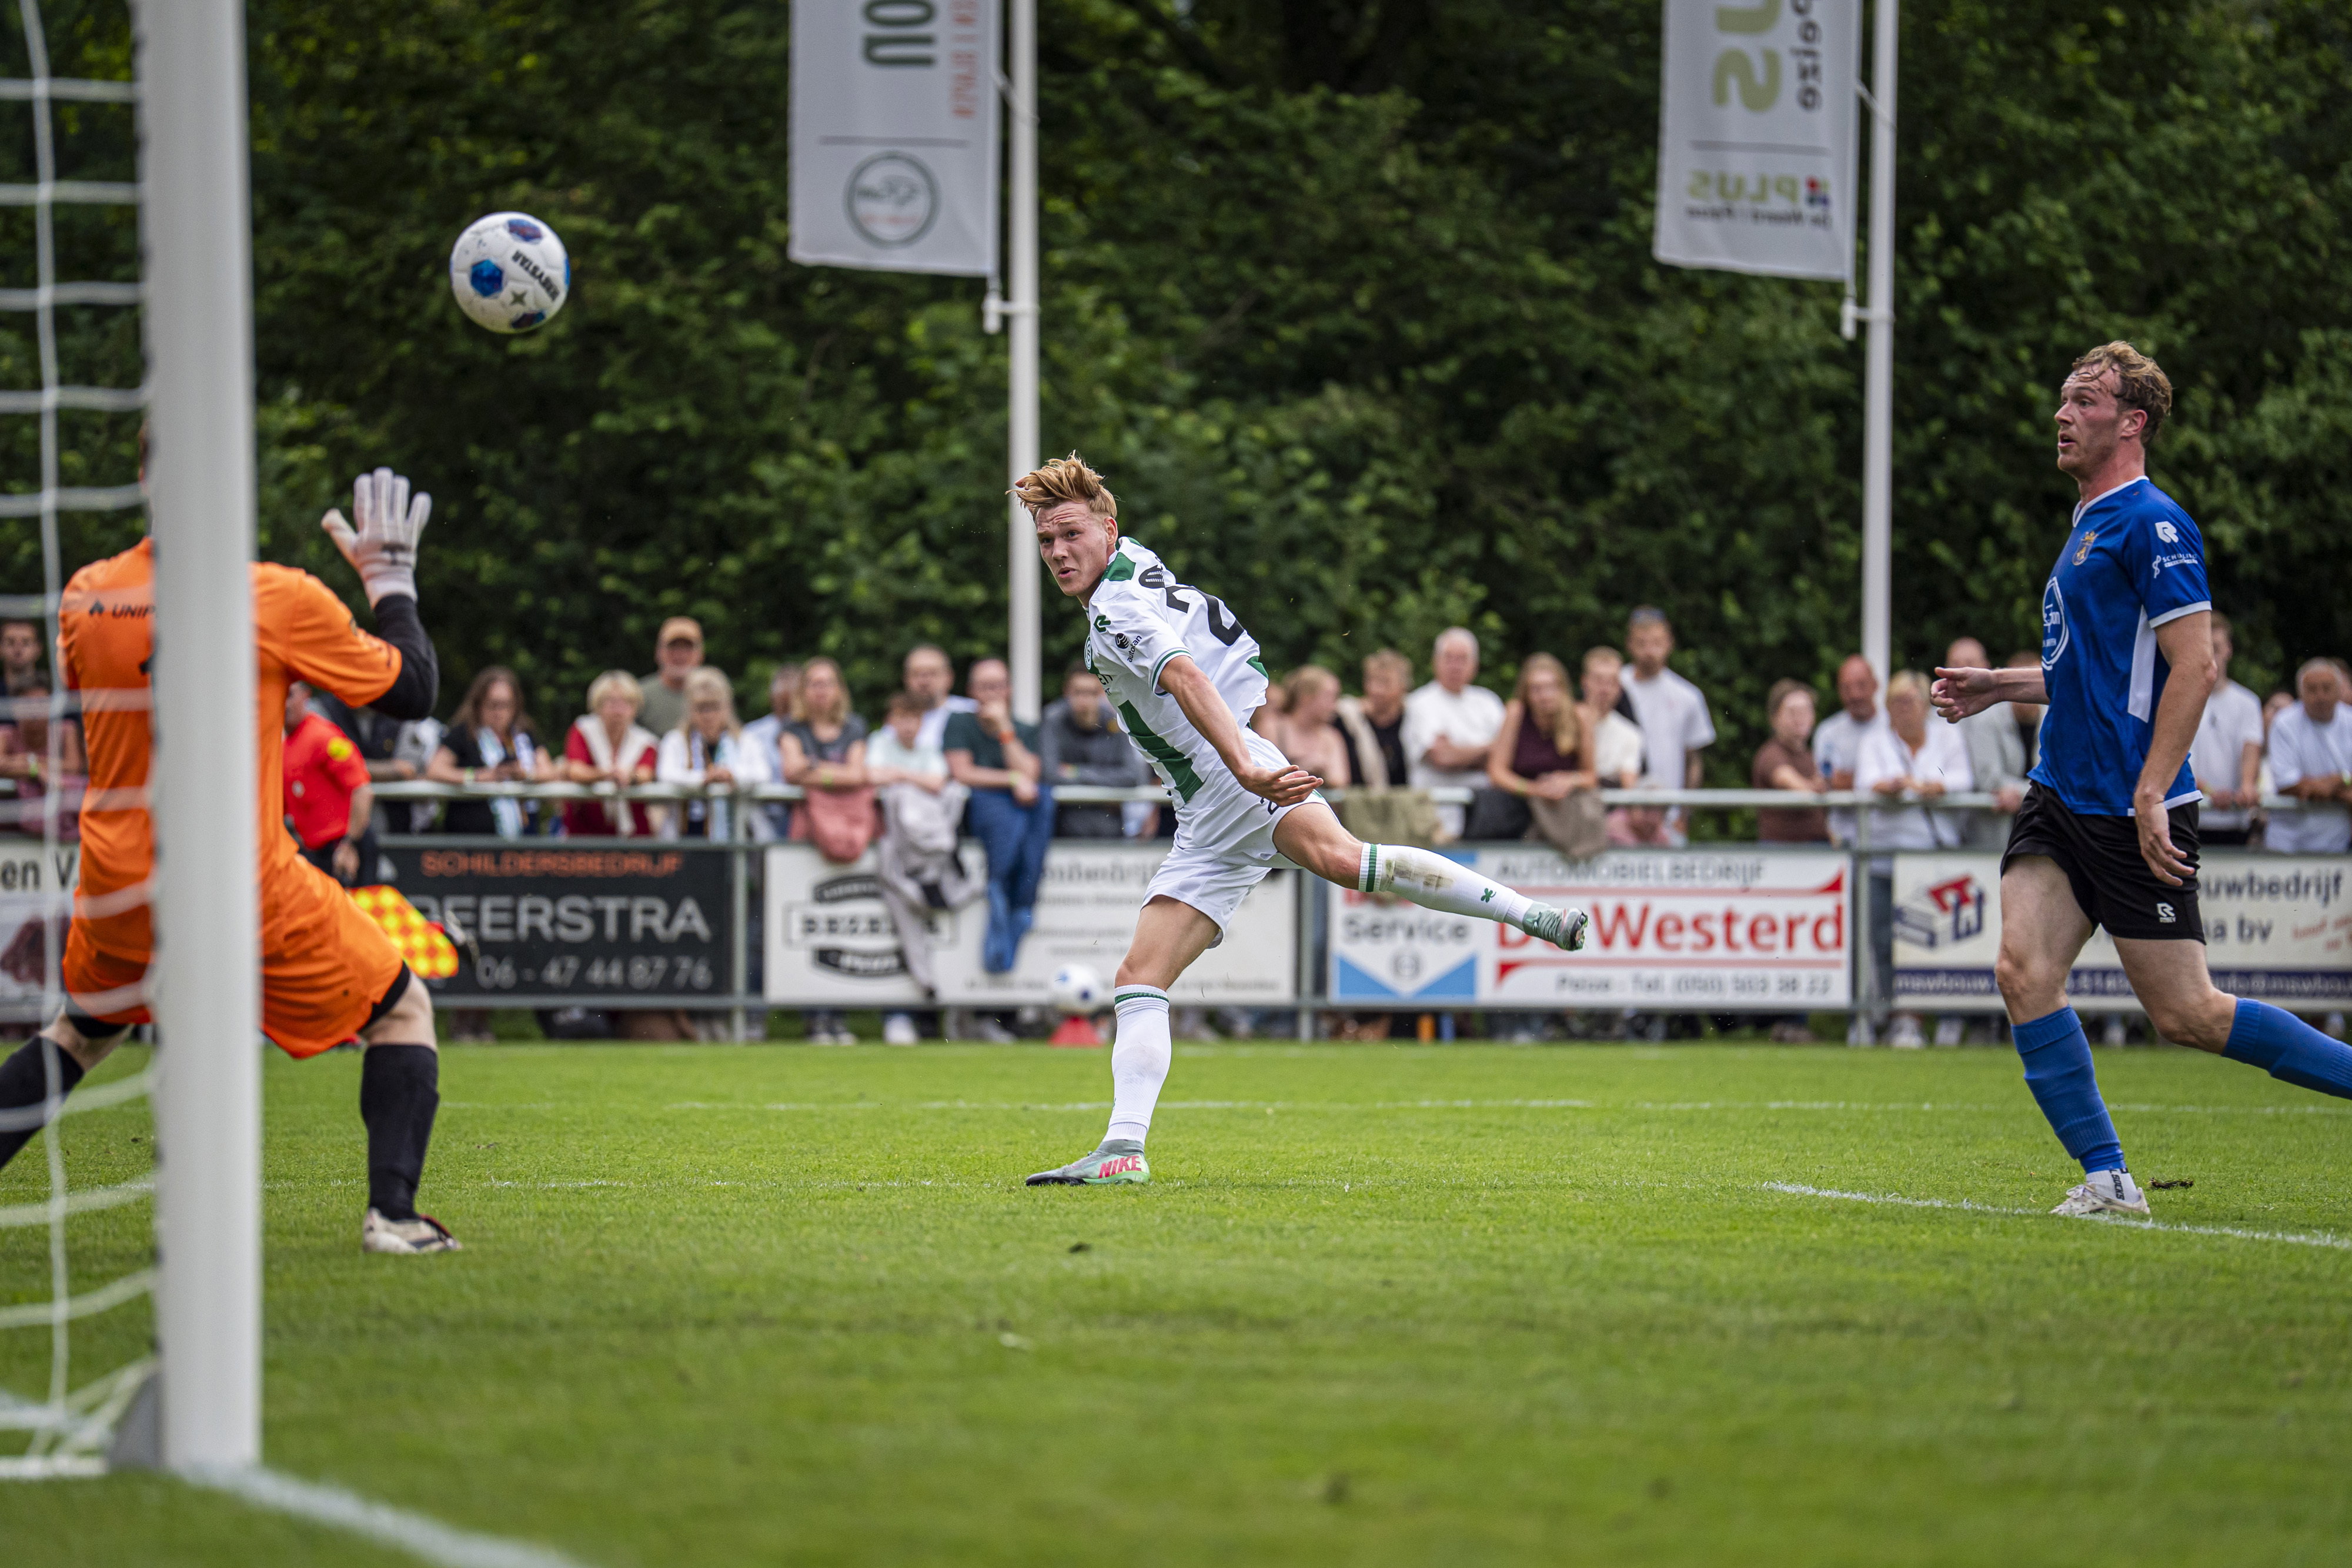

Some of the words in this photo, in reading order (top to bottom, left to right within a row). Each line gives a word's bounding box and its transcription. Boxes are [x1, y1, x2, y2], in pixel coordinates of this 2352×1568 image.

[2201, 870, 2343, 907] uwbedrijf
[1590, 900, 1844, 952] Westerd
[475, 954, 517, 990] 06
[1098, 1155, 1142, 1178] NIKE
[2111, 1174, 2125, 1201] SOCKS
